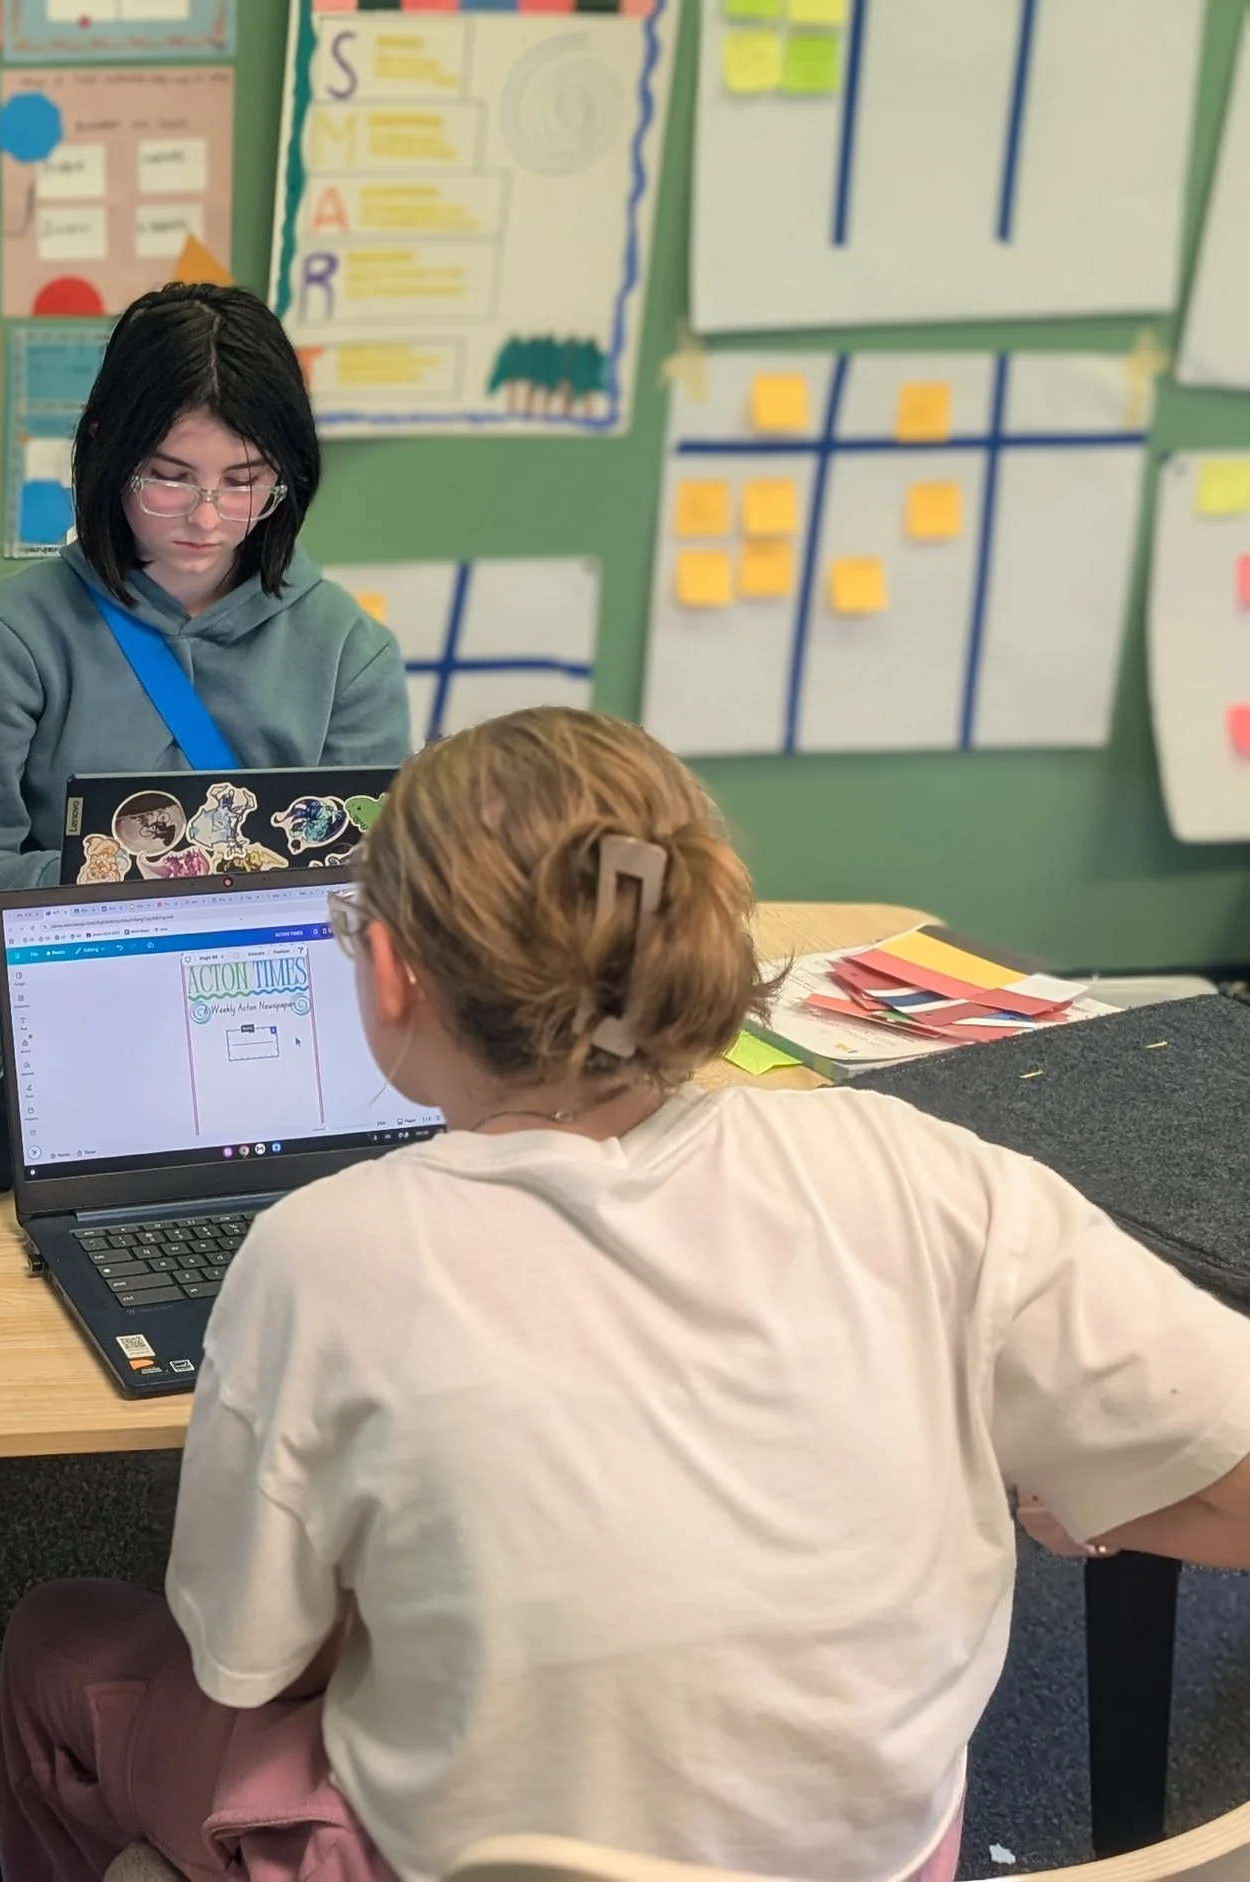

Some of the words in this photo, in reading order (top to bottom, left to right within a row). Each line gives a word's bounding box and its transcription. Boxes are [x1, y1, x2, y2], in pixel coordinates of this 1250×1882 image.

[325, 30, 357, 100] S
[314, 112, 357, 168] M
[313, 187, 349, 230] A
[300, 252, 339, 323] R
[69, 800, 80, 833] Lenovo
[188, 961, 248, 993] ACTON
[253, 957, 307, 988] TIMES
[211, 1004, 236, 1017] Weekly
[237, 1003, 257, 1012] Acton
[259, 1001, 295, 1012] Newspaper
